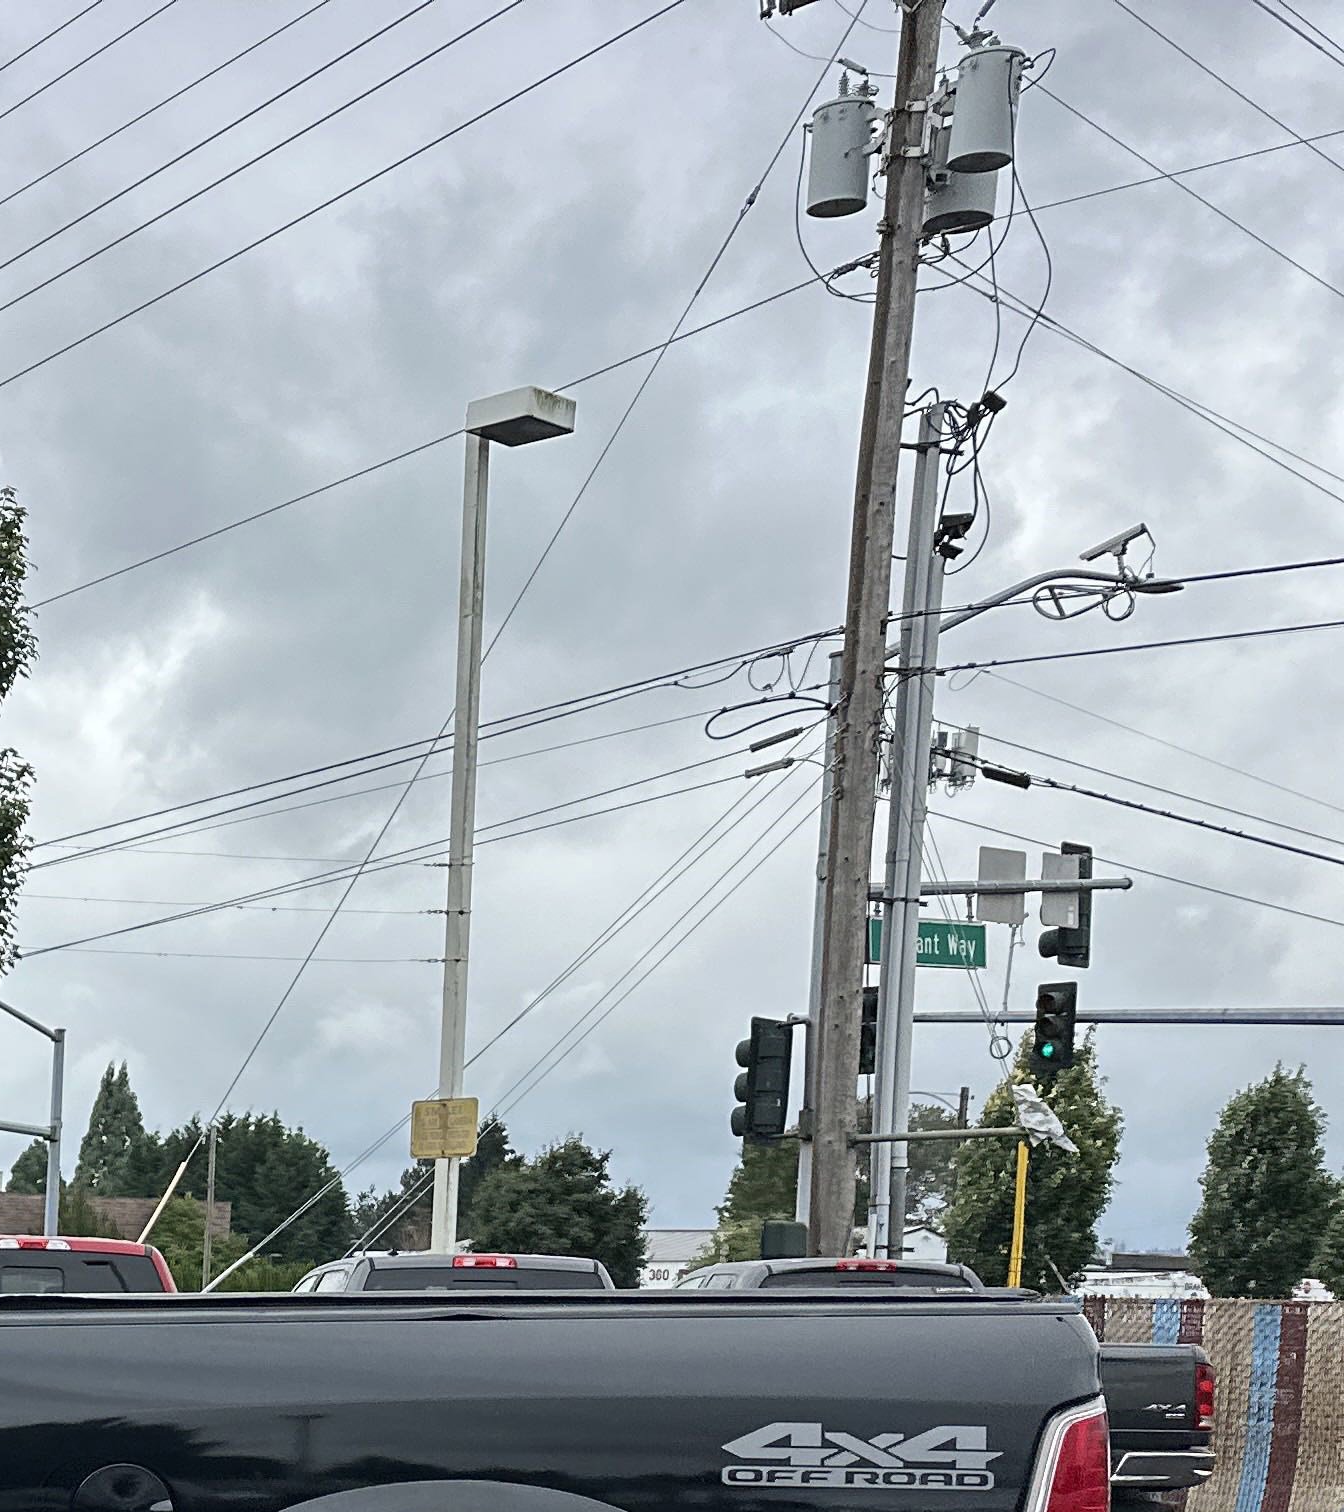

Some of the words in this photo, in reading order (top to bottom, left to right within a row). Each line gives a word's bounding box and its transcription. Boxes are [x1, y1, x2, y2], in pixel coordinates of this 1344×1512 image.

[916, 933, 939, 955] ant
[947, 933, 976, 962] Way
[727, 1468, 833, 1484] OFF
[844, 1470, 990, 1487] ROAD
